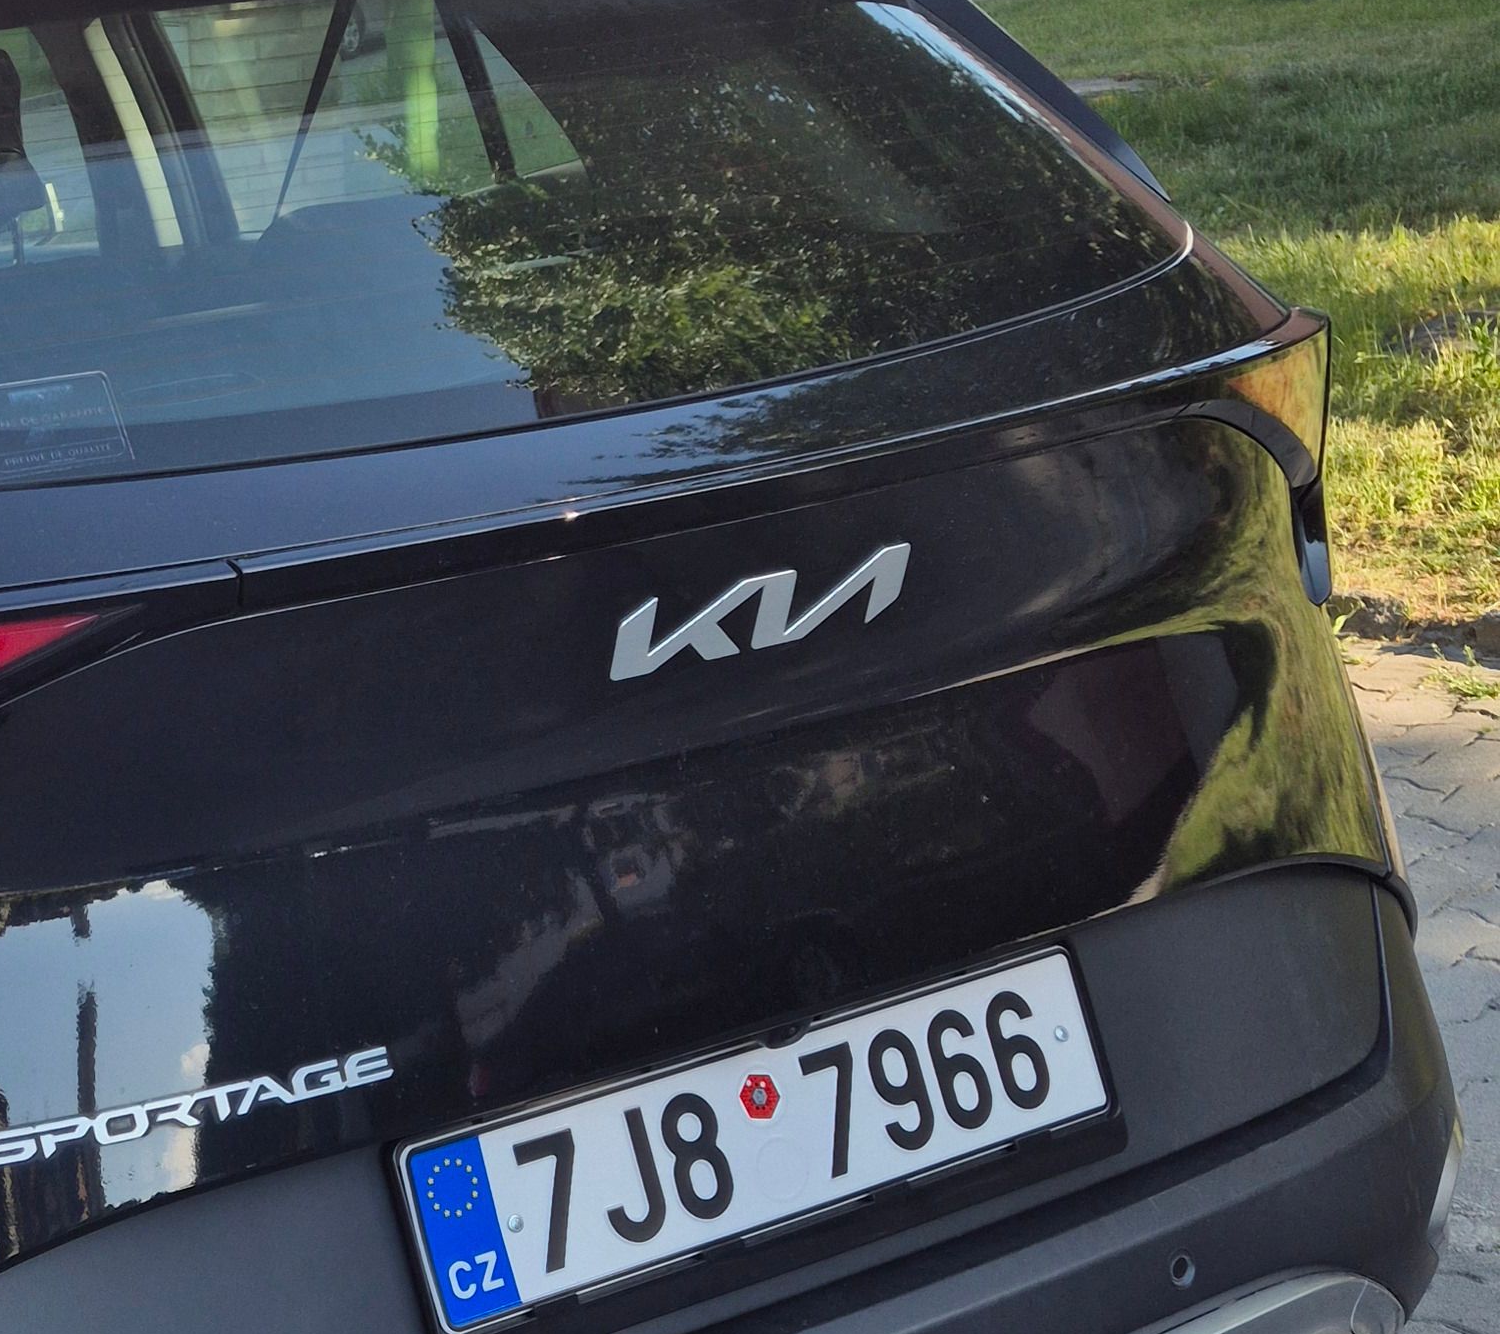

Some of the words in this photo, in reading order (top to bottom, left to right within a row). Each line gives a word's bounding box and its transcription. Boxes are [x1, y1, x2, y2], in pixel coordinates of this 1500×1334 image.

[609, 542, 911, 681] KIA
[512, 1092, 733, 1274] 7J8
[798, 991, 1050, 1178] 7966
[448, 1250, 505, 1299] CZ
